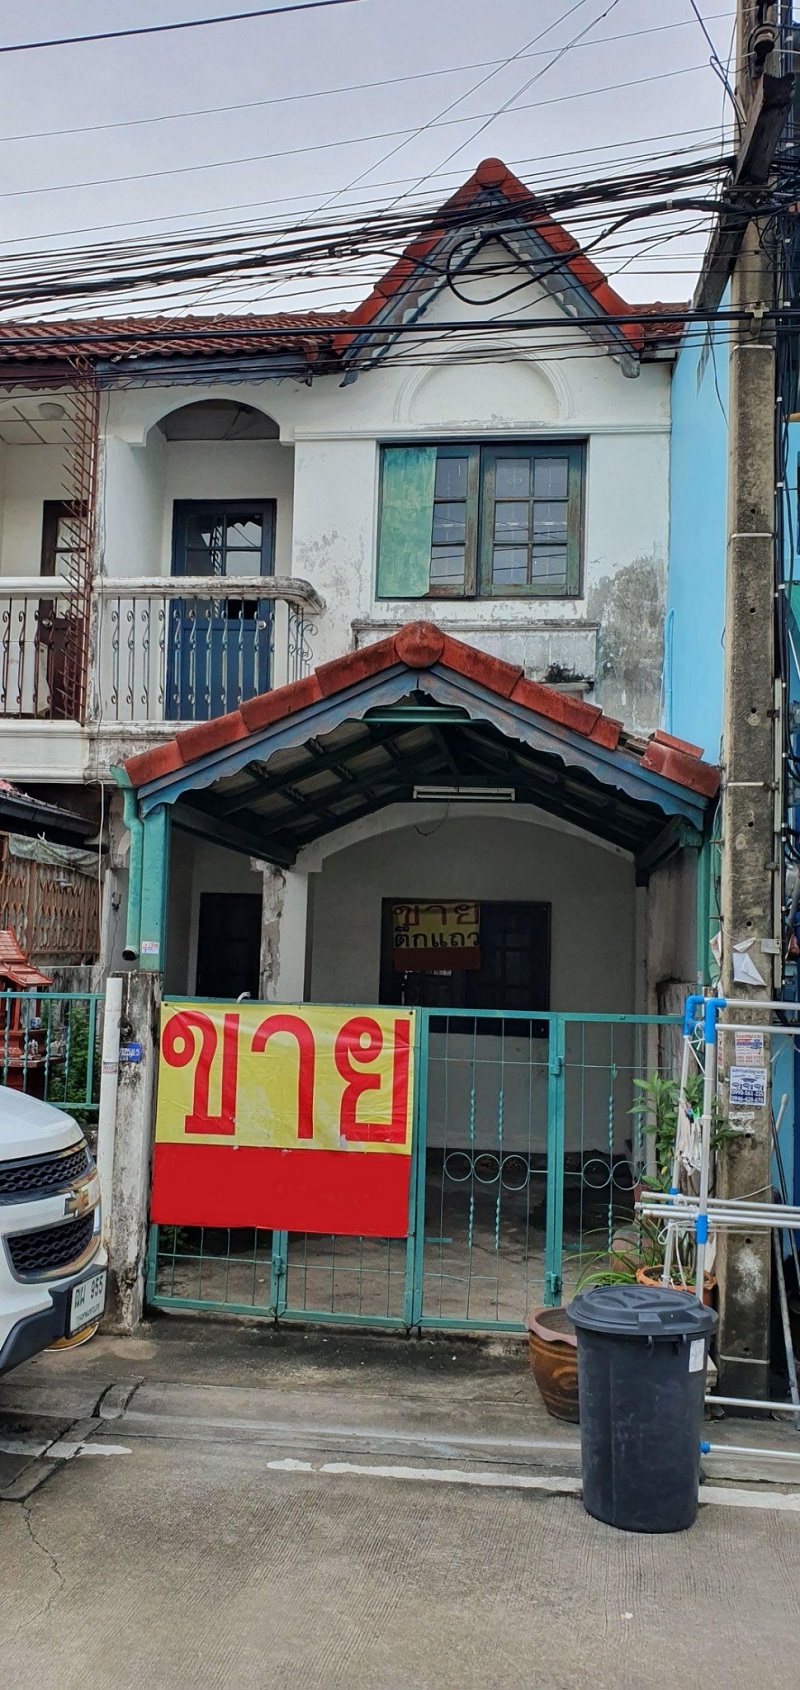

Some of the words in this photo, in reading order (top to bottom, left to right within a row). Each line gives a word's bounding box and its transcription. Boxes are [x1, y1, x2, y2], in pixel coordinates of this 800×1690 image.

[393, 904, 480, 926] ขาย
[394, 923, 480, 948] ตึกแถว
[161, 1010, 411, 1144] ขาย
[91, 1275, 103, 1299] 955
